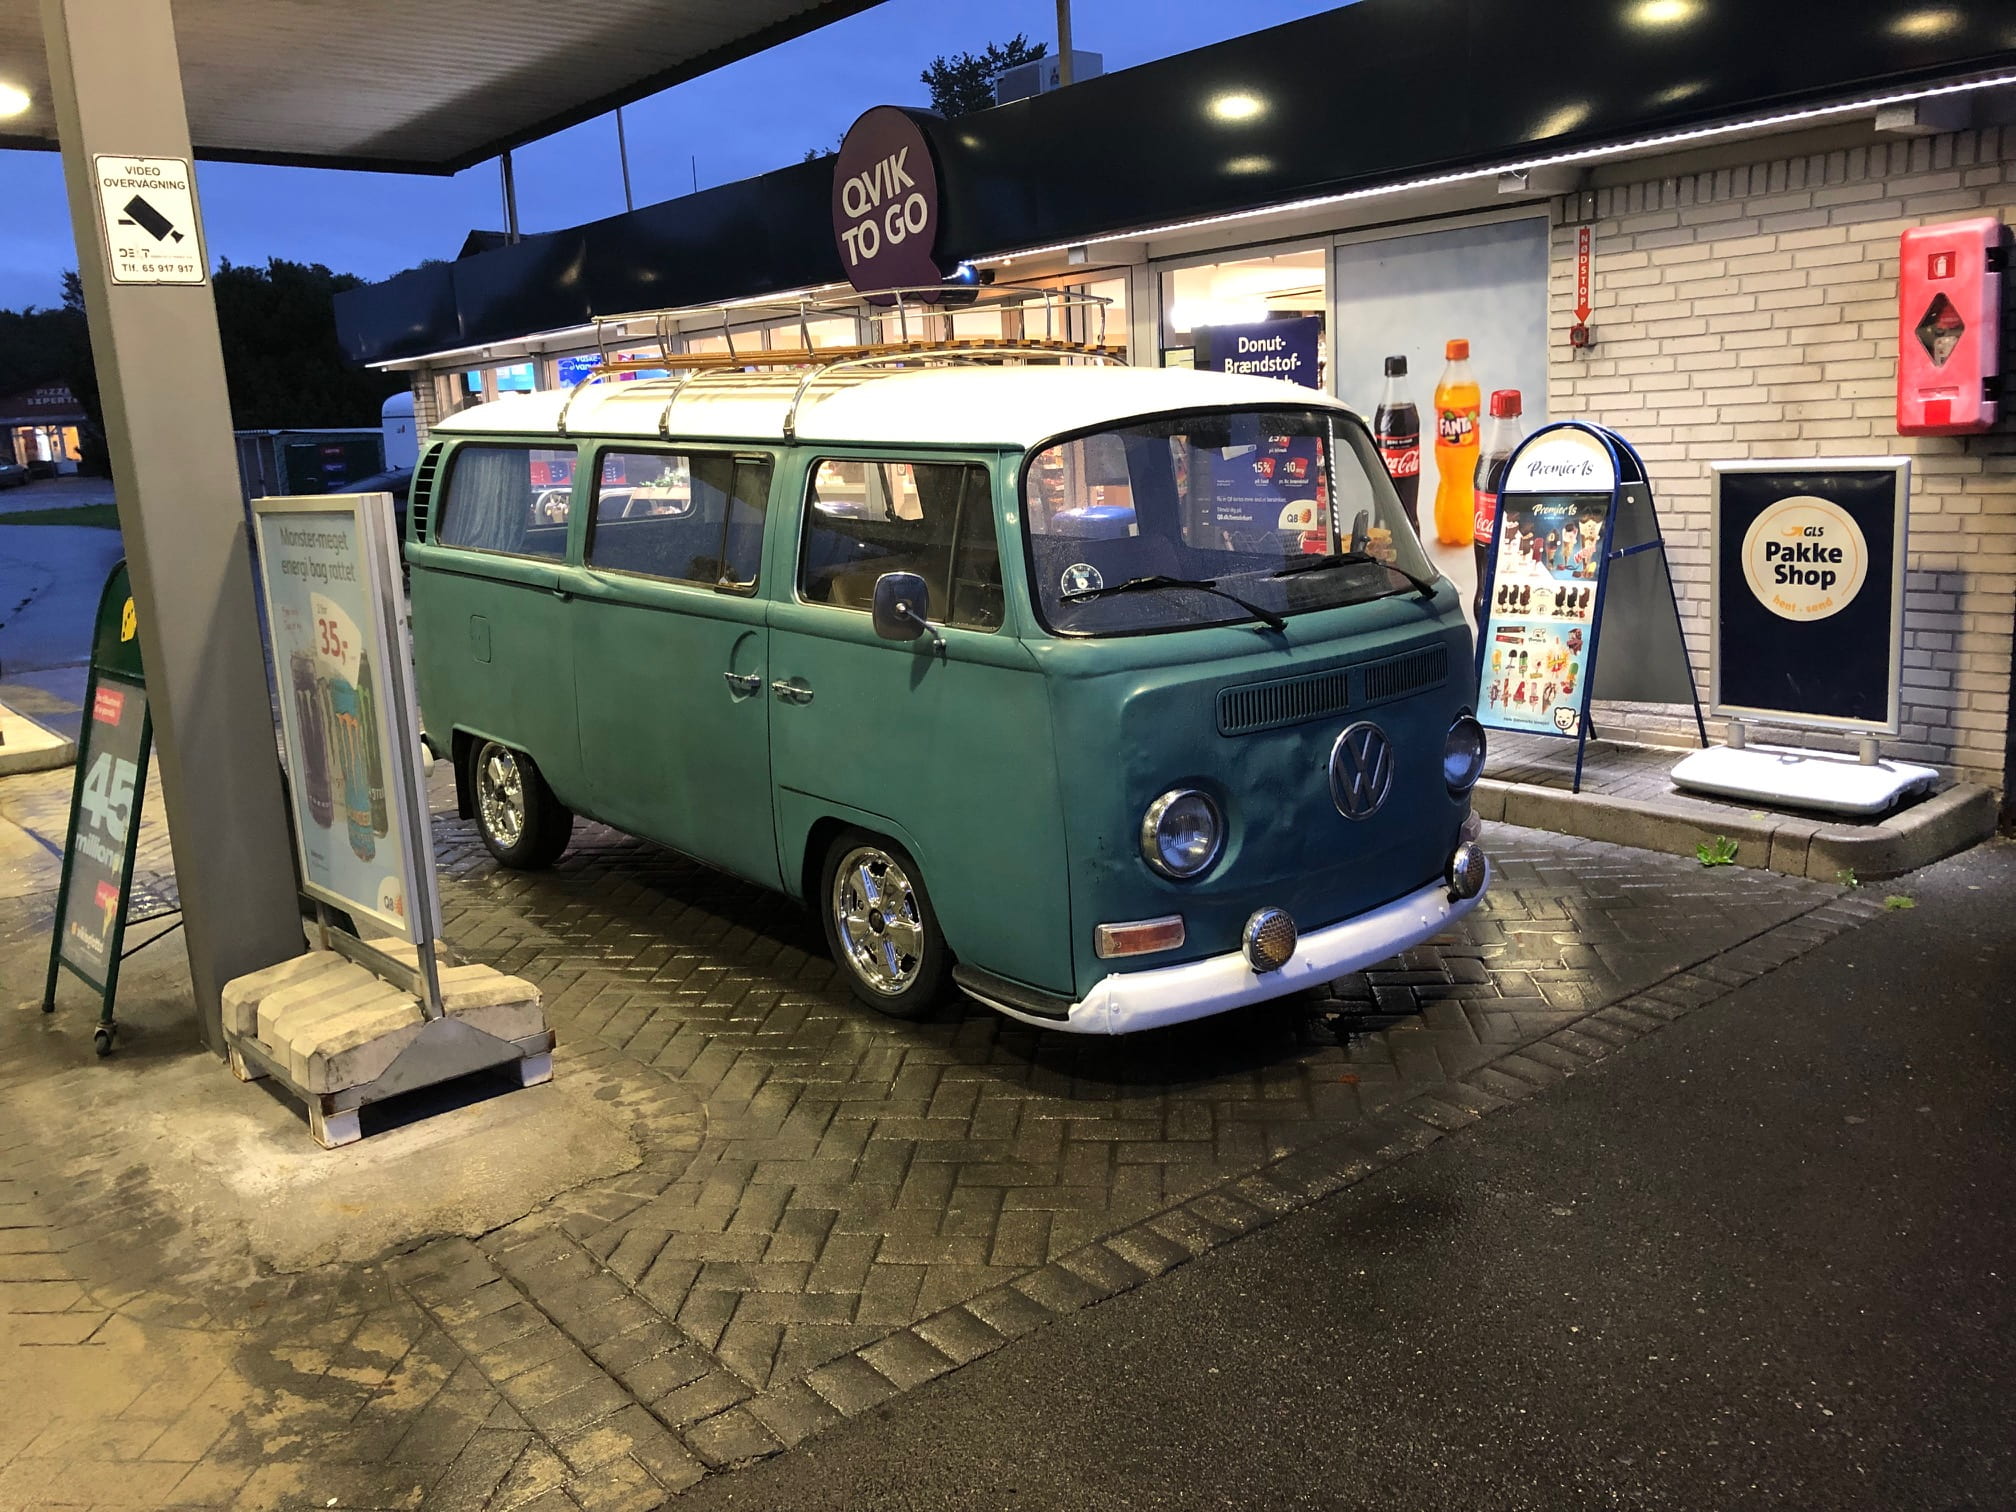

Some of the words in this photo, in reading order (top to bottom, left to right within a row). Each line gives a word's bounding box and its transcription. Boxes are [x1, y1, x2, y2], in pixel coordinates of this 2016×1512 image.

[124, 165, 161, 176] VIDEO
[842, 146, 915, 218] QVIK
[842, 219, 880, 266] TO
[885, 192, 928, 245] GO
[121, 263, 139, 273] Tlf.
[142, 264, 155, 273] 65
[158, 264, 174, 273] 917
[177, 264, 194, 273] 917
[1580, 234, 1589, 306] NØDSTOP
[1238, 335, 1287, 354] Donut-
[1224, 352, 1302, 374] Brændstof-
[1252, 461, 1271, 473] 15%
[1527, 460, 1580, 477] Premier
[1287, 514, 1299, 523] Q8
[1532, 504, 1567, 516] Premier
[280, 527, 349, 556] Monster-meget
[1804, 526, 1825, 537] GLS
[1766, 541, 1843, 563] Pakke
[308, 556, 328, 584] bag
[1774, 564, 1836, 591] Shop
[1773, 594, 1797, 613] hent
[1805, 596, 1833, 613] send
[1330, 722, 1393, 819] VW
[81, 752, 138, 842] 45
[383, 895, 395, 912] Q8
